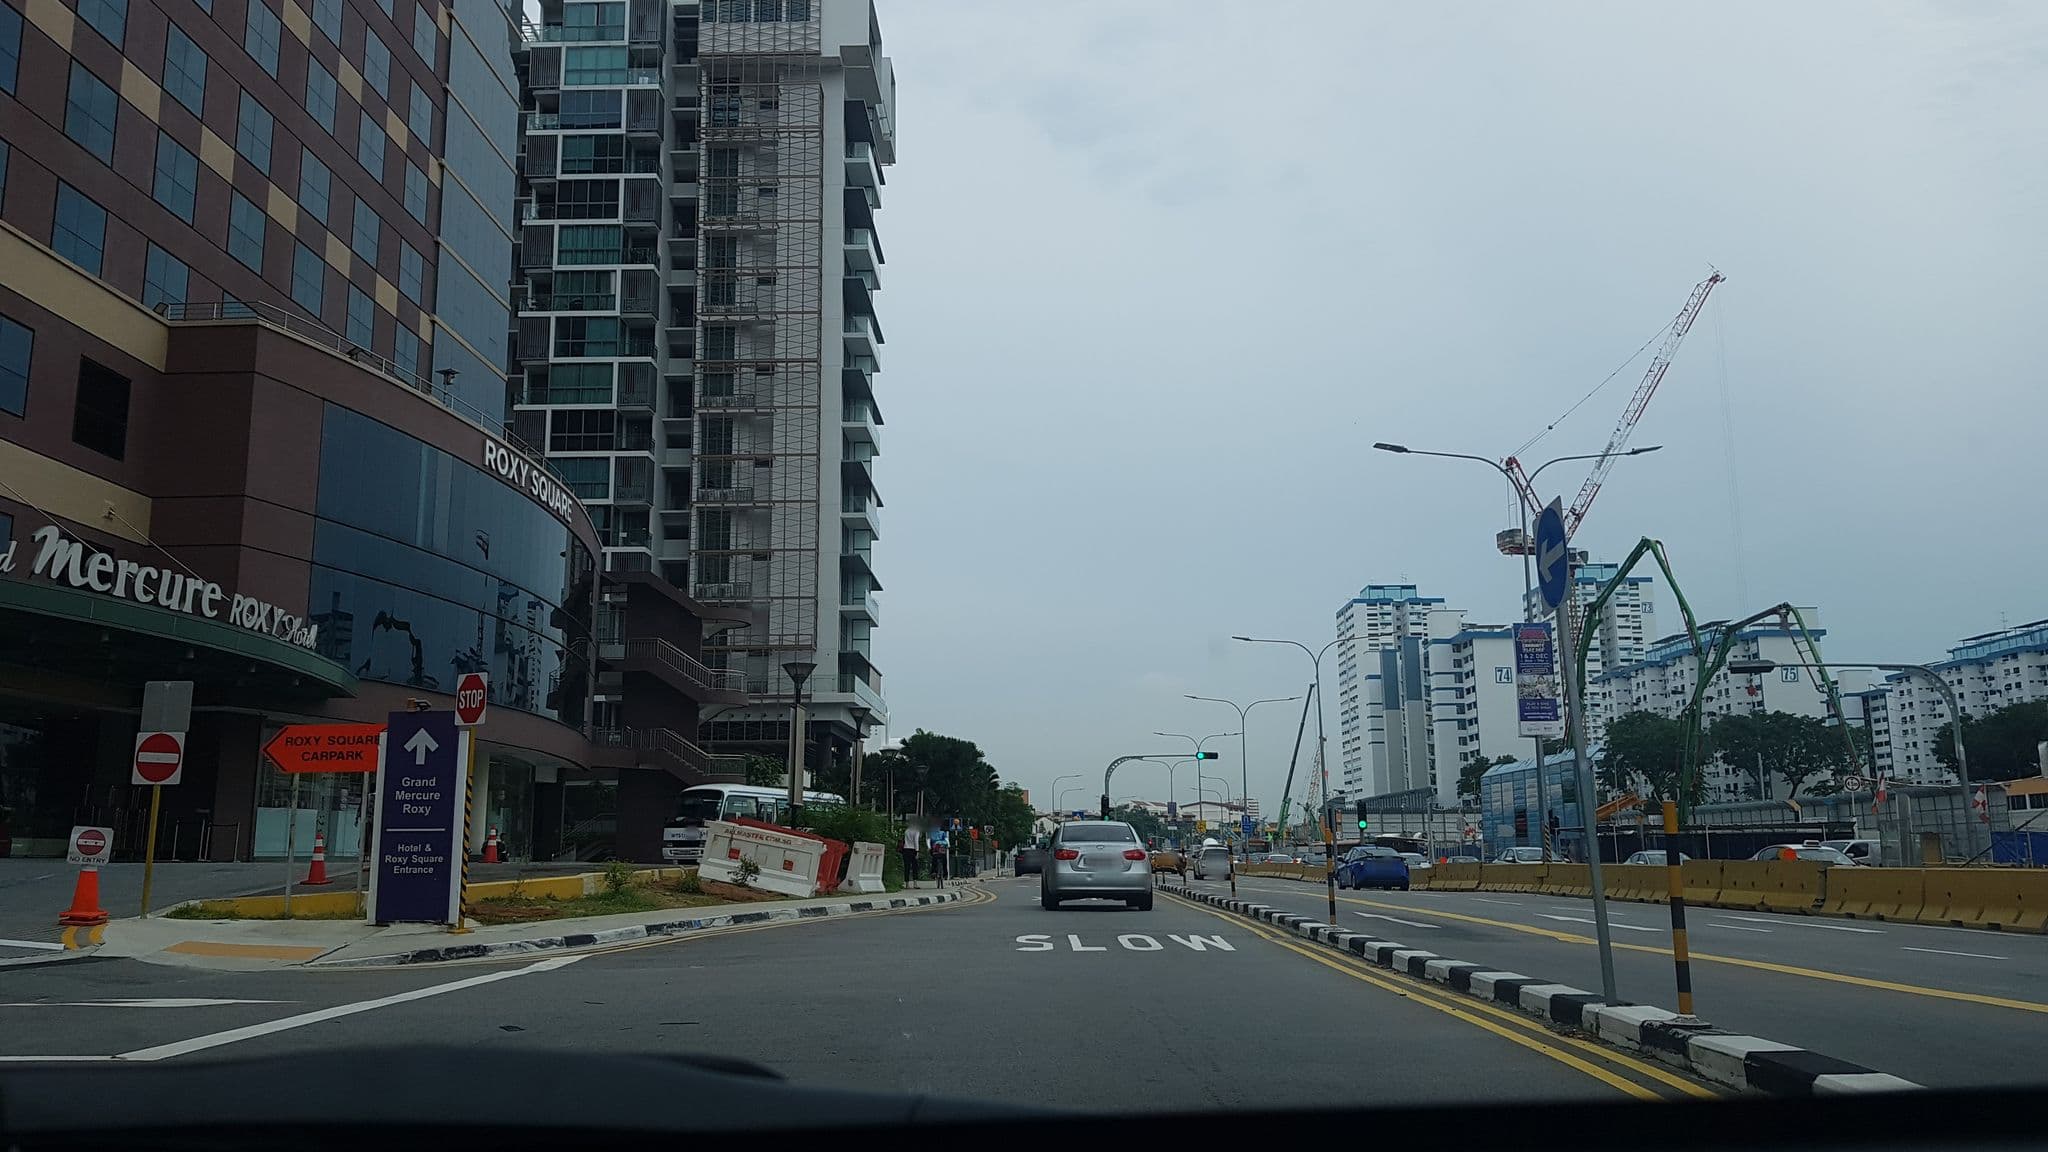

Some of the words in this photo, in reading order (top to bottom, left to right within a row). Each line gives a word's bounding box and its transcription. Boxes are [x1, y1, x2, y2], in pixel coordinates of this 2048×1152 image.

[485, 439, 528, 487] ROXY
[531, 470, 572, 523] SQUARE
[32, 525, 222, 618] Mercure
[229, 593, 293, 639] ROXY
[285, 614, 319, 650] Hotel
[1497, 668, 1510, 682] 74
[1783, 667, 1796, 680] 75
[459, 690, 483, 708] STOP
[285, 736, 321, 746] ROXY
[301, 751, 363, 762] CARPARK
[401, 777, 436, 787] Grand
[395, 790, 440, 800] Mercure
[402, 804, 431, 816] Roxy
[397, 844, 421, 852] Hotel
[425, 844, 431, 852] &
[385, 855, 407, 865] Roxy
[411, 855, 443, 865] Square
[393, 865, 434, 874] Entrance
[1015, 934, 1236, 952] SLOW
